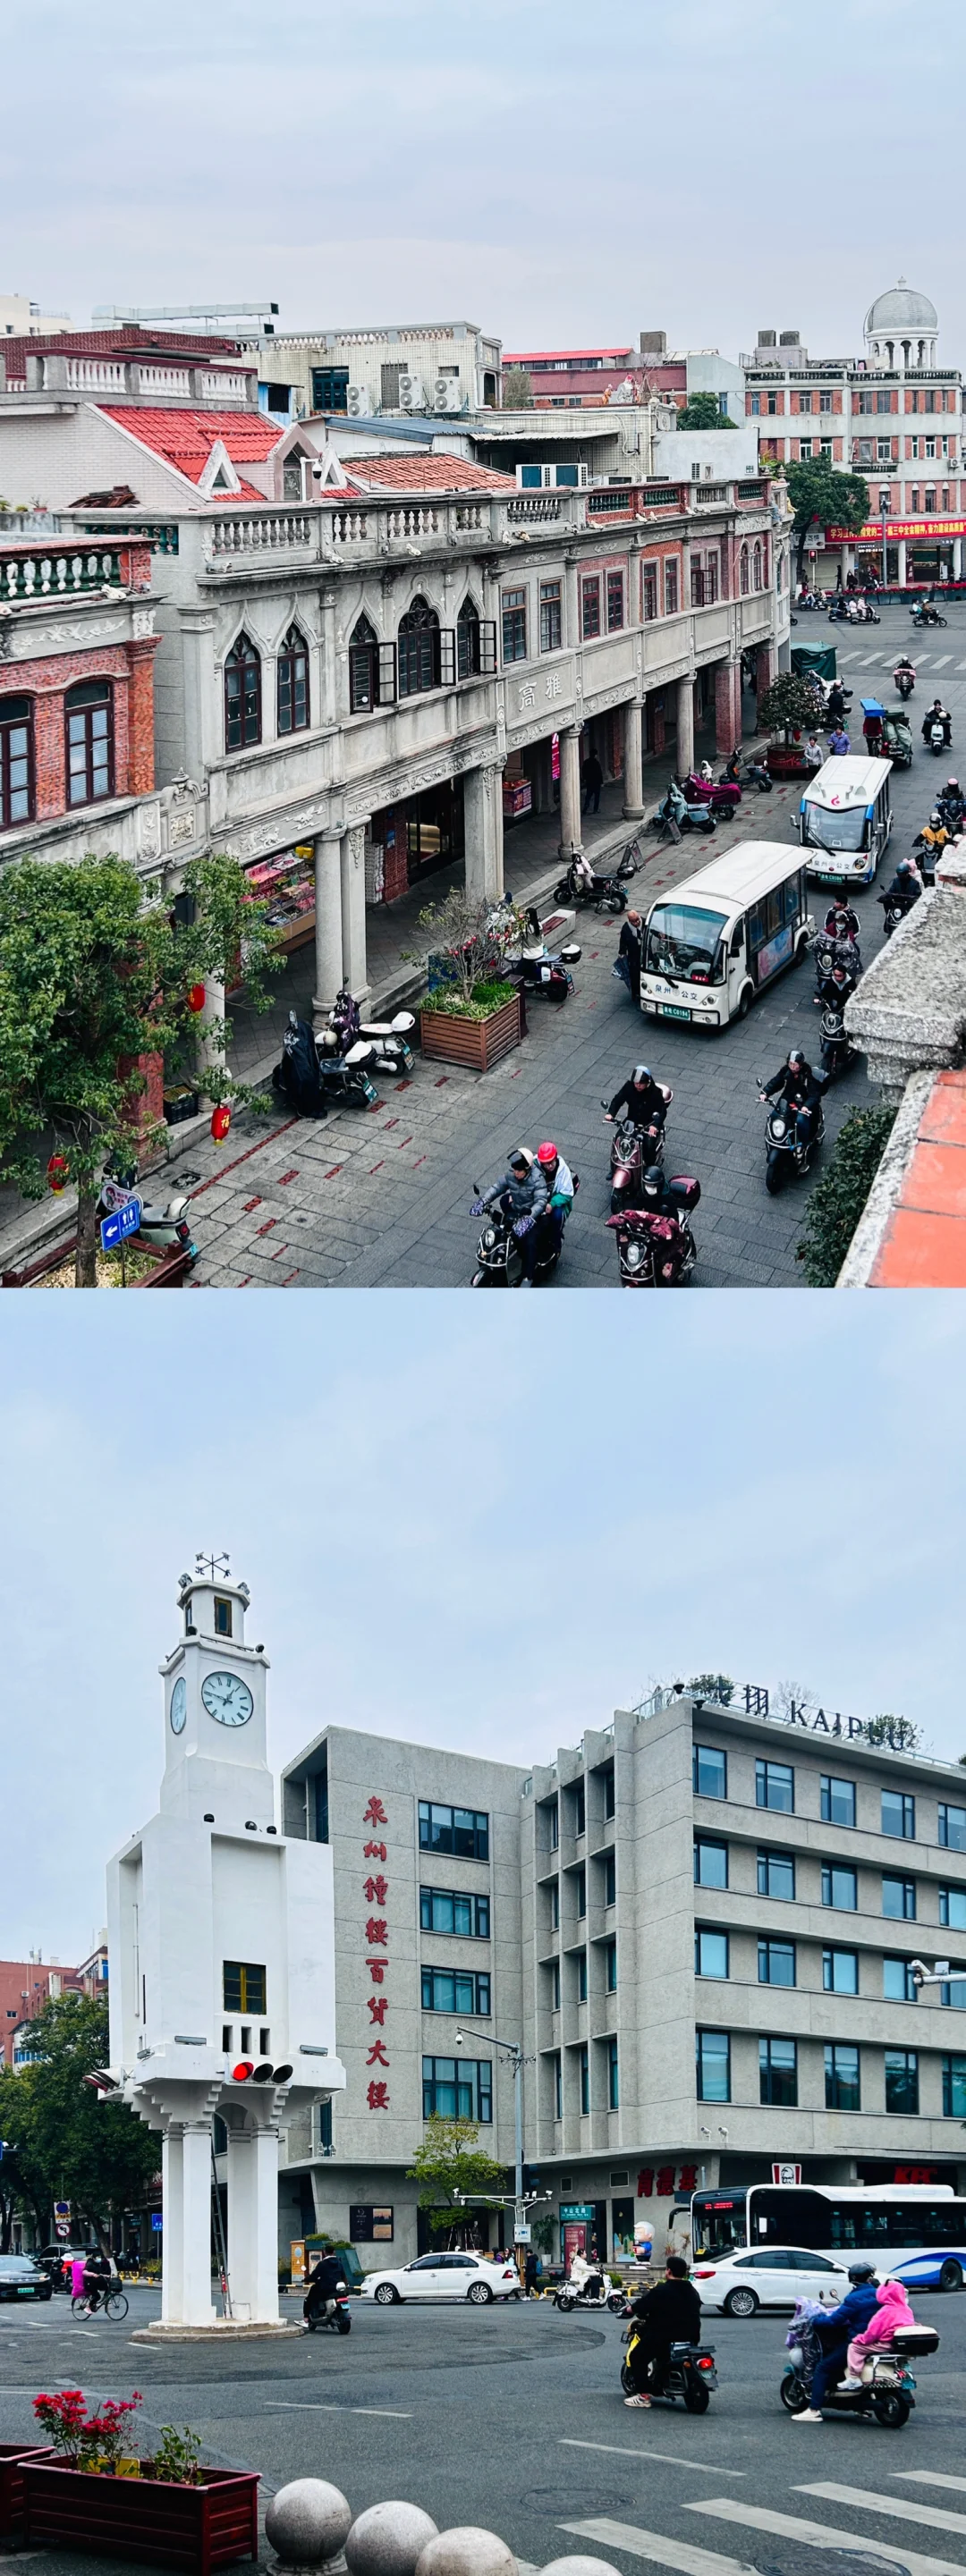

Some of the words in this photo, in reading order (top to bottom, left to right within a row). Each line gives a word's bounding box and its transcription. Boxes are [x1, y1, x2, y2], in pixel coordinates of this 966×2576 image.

[221, 1115, 231, 1128] 福
[637, 2164, 699, 2198] 肯德基
[894, 2166, 939, 2184] KFC
